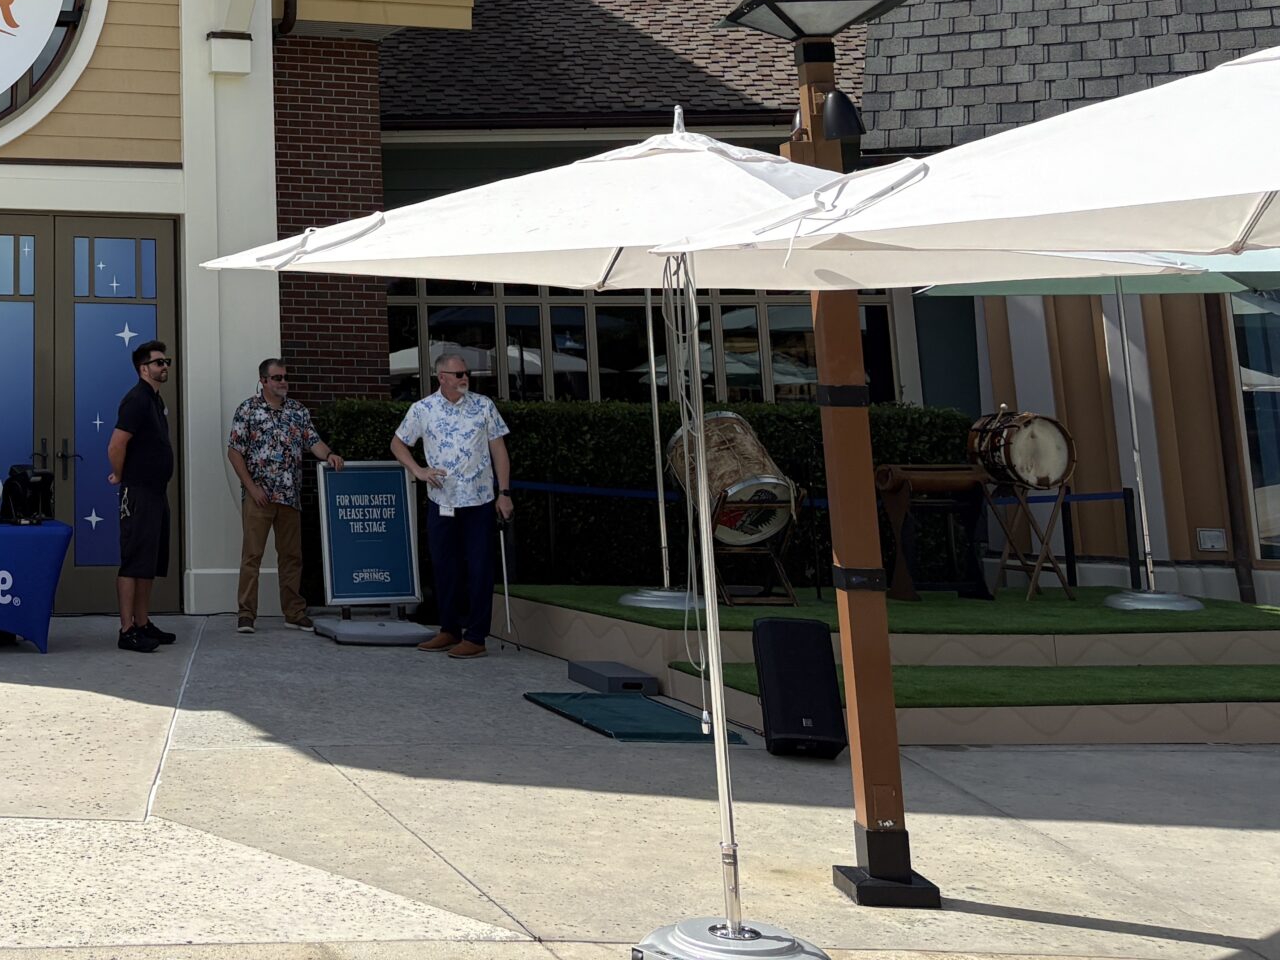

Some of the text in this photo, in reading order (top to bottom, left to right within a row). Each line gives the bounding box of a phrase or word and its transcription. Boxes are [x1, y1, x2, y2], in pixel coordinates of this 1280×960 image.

[336, 494, 396, 506] FOR YOUR SAFETY
[338, 508, 396, 520] PLEASE STAY OFF
[350, 521, 387, 533] THE STAGE
[352, 571, 391, 583] SPRINGS
